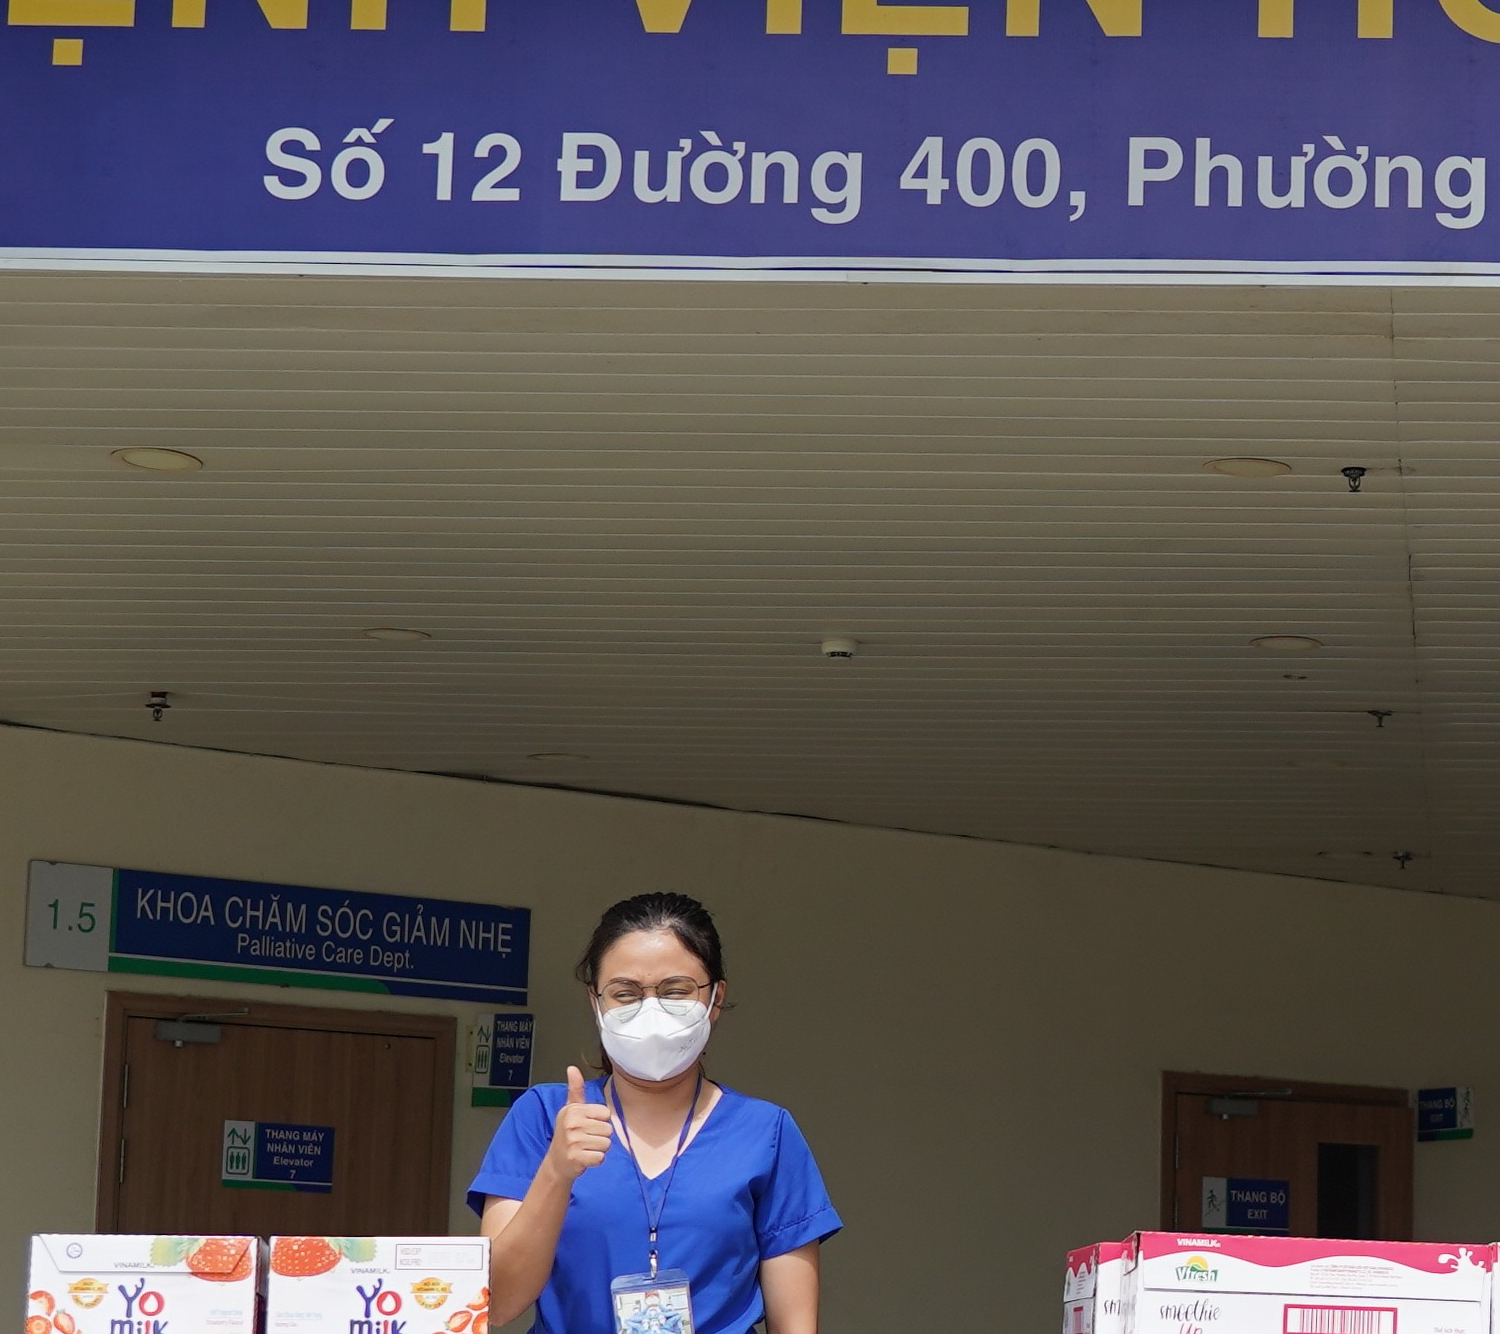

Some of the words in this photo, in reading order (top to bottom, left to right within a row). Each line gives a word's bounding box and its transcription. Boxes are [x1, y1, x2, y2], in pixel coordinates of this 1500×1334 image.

[262, 118, 393, 204] Số
[420, 131, 522, 202] 12
[557, 128, 864, 222] Đường
[899, 136, 1087, 221] 400,
[1126, 136, 1487, 229] Phường
[48, 898, 96, 934] 1.5
[136, 888, 214, 927] KHOA
[225, 894, 306, 934] CHĂM
[317, 901, 373, 940] SÓC
[383, 905, 449, 947] GIẢM
[459, 919, 514, 959] NHẸ
[237, 934, 316, 960] Palliative
[322, 941, 363, 964] Care
[370, 945, 414, 972] Dept.
[497, 1021, 518, 1032] THANG
[266, 1128, 300, 1141] THANG
[302, 1128, 325, 1143] MÁY
[266, 1141, 296, 1155] NHÂN
[298, 1142, 322, 1157] VIÊN
[273, 1156, 314, 1168] Elevator
[289, 1169, 296, 1179] 7
[1231, 1190, 1267, 1204] THANG
[1269, 1189, 1286, 1206] BỘ
[1247, 1208, 1268, 1220] EXIT
[1176, 1266, 1218, 1283] Vfresh
[1159, 1298, 1221, 1323] smoothie
